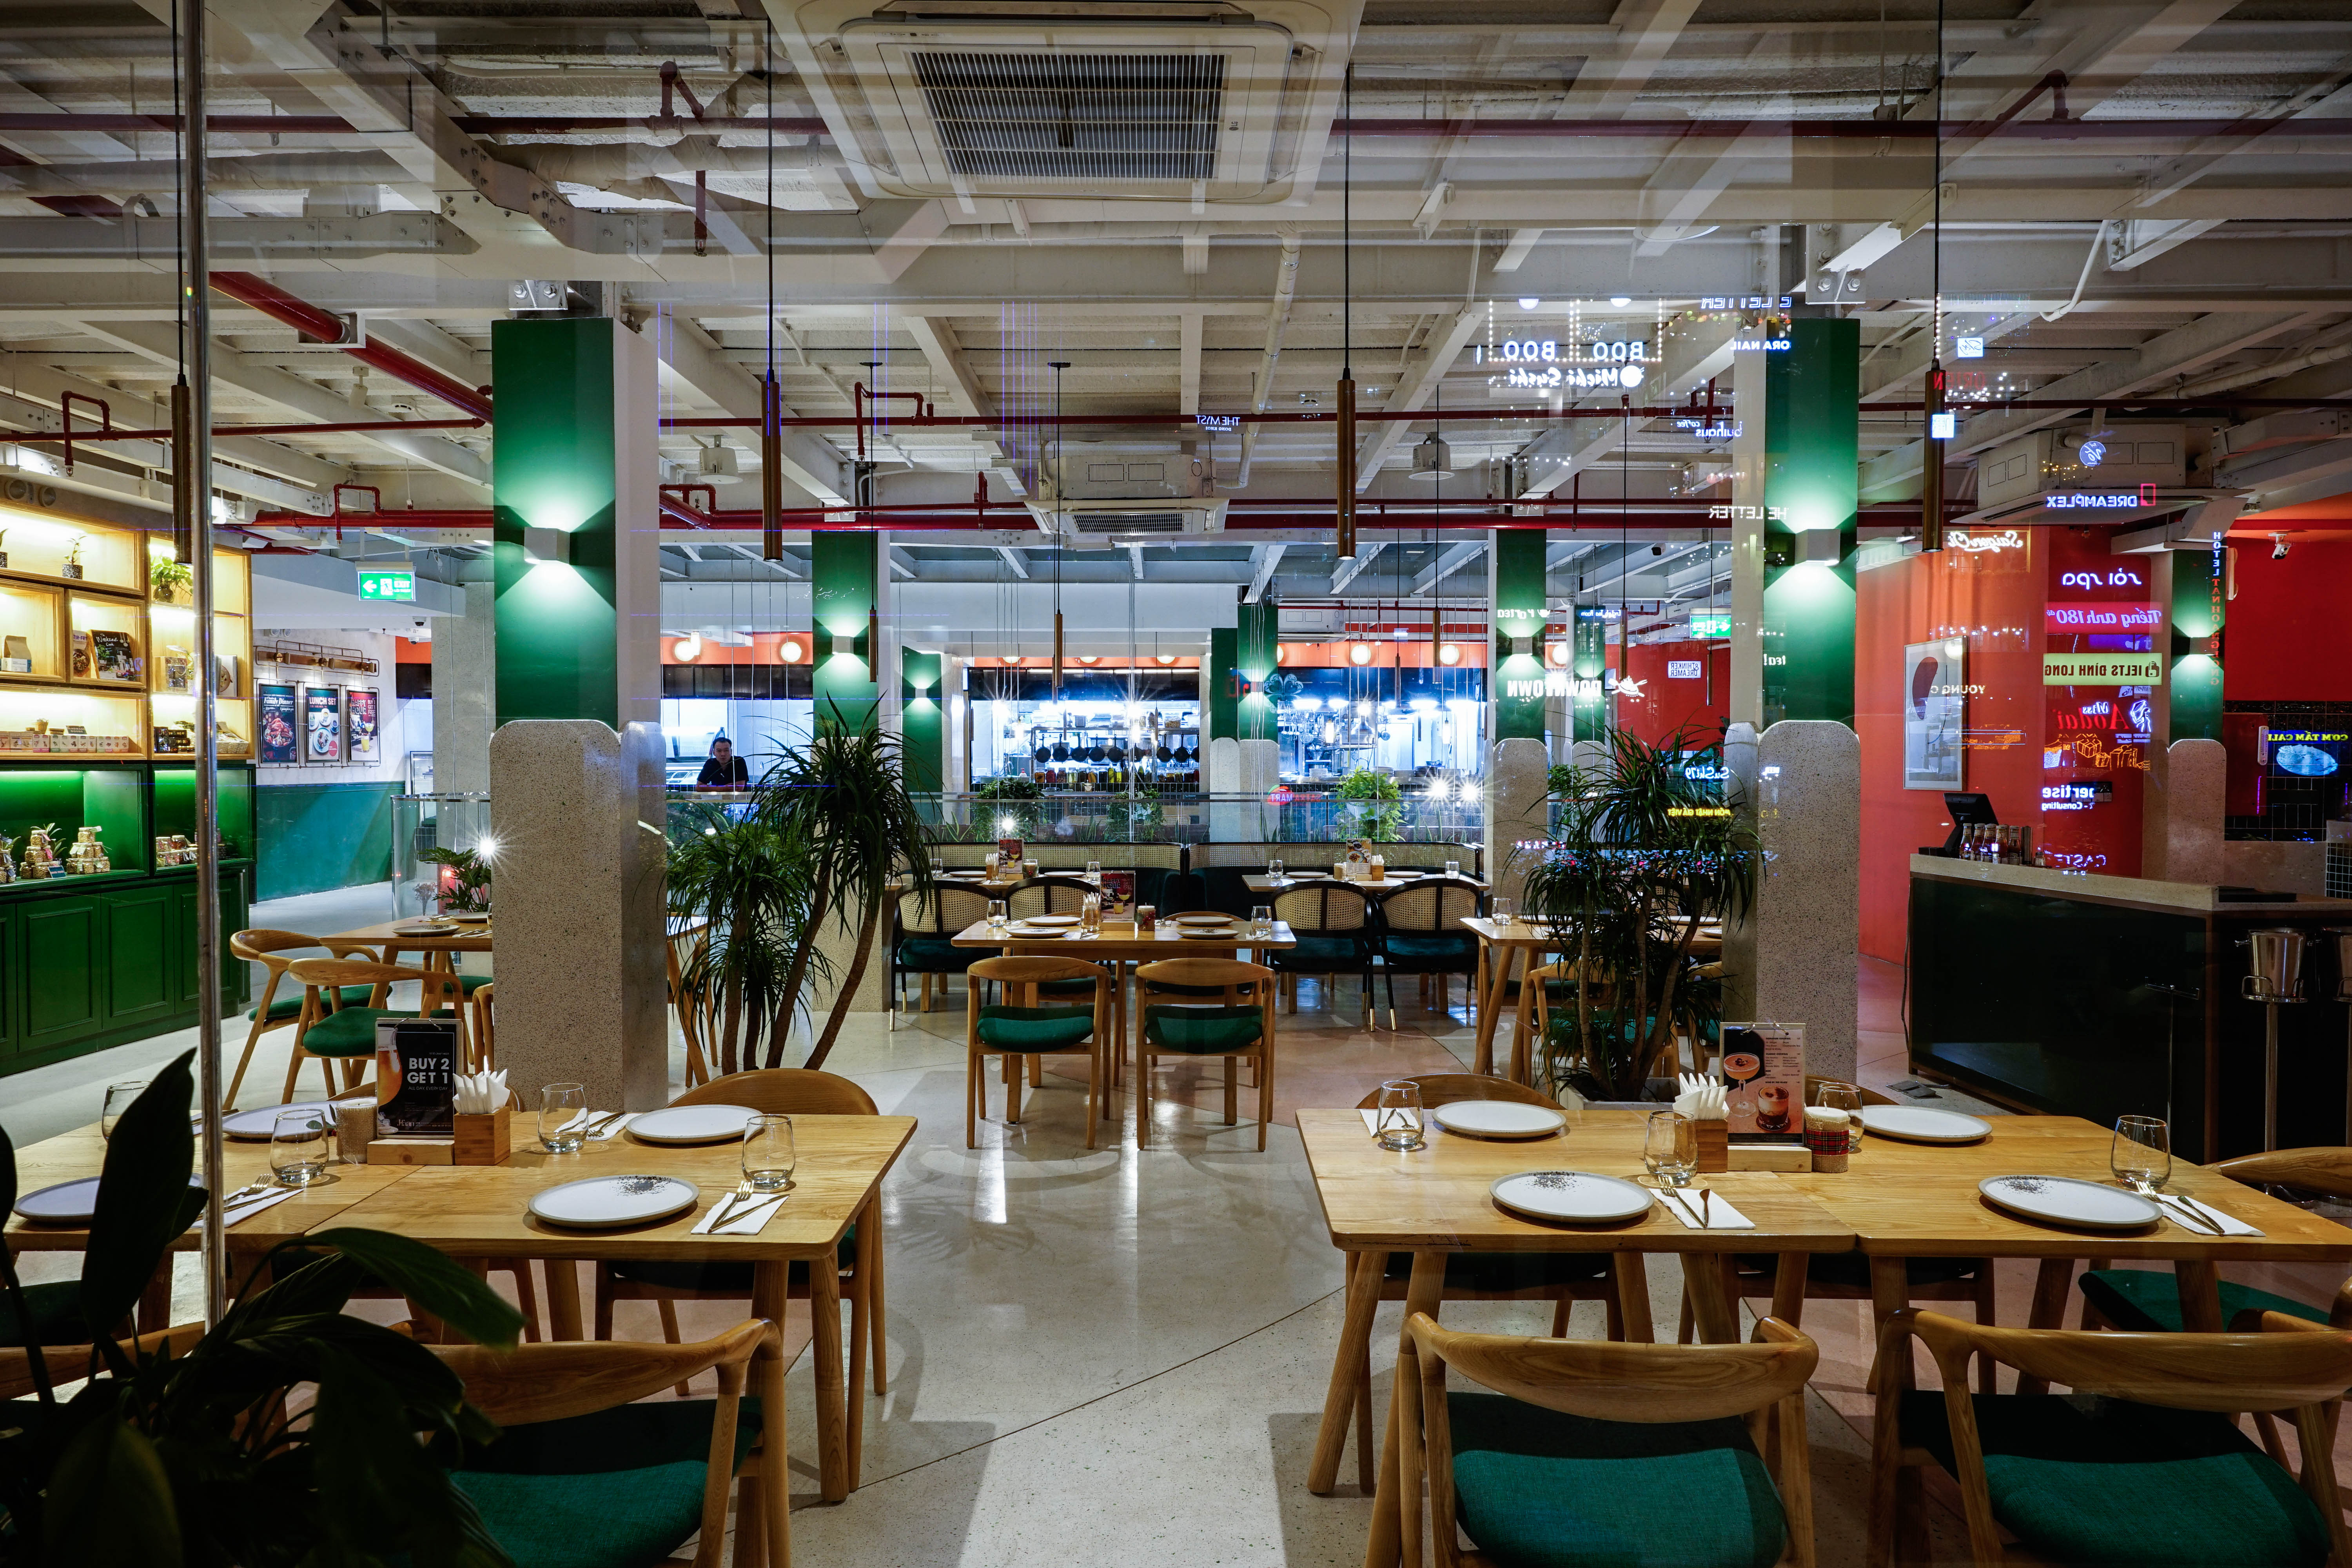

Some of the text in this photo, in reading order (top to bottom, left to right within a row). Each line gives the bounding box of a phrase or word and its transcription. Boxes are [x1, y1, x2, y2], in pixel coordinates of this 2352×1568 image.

[409, 1058, 449, 1070] BUY 2
[407, 1072, 448, 1084] GET 1
